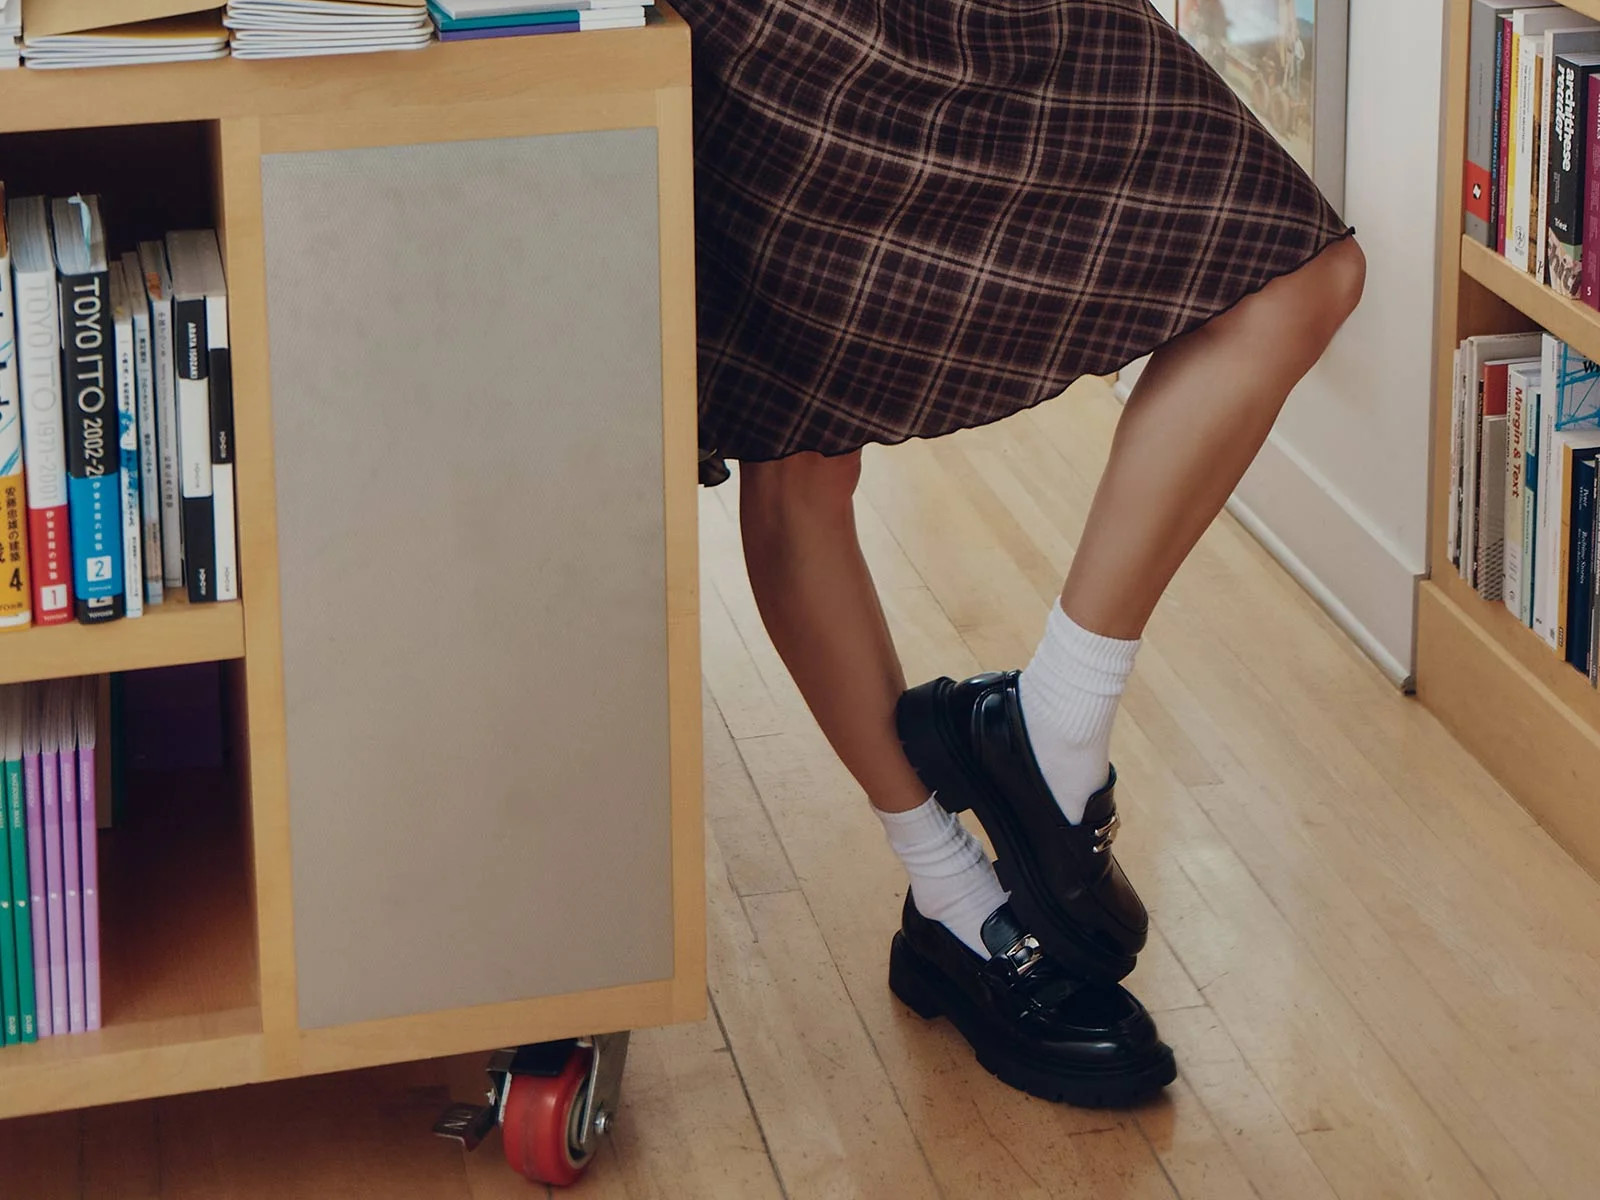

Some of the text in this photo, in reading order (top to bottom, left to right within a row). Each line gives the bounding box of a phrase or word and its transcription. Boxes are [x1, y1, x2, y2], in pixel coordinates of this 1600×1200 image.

[1554, 63, 1566, 142] reader
[1562, 67, 1576, 172] archithese
[24, 278, 55, 349] TOYO
[73, 276, 103, 350] TOYO
[29, 353, 58, 413] ITO
[75, 354, 106, 413] ITO
[1509, 386, 1523, 499] Margin & Text
[9, 568, 23, 592] 4
[95, 560, 105, 578] 2
